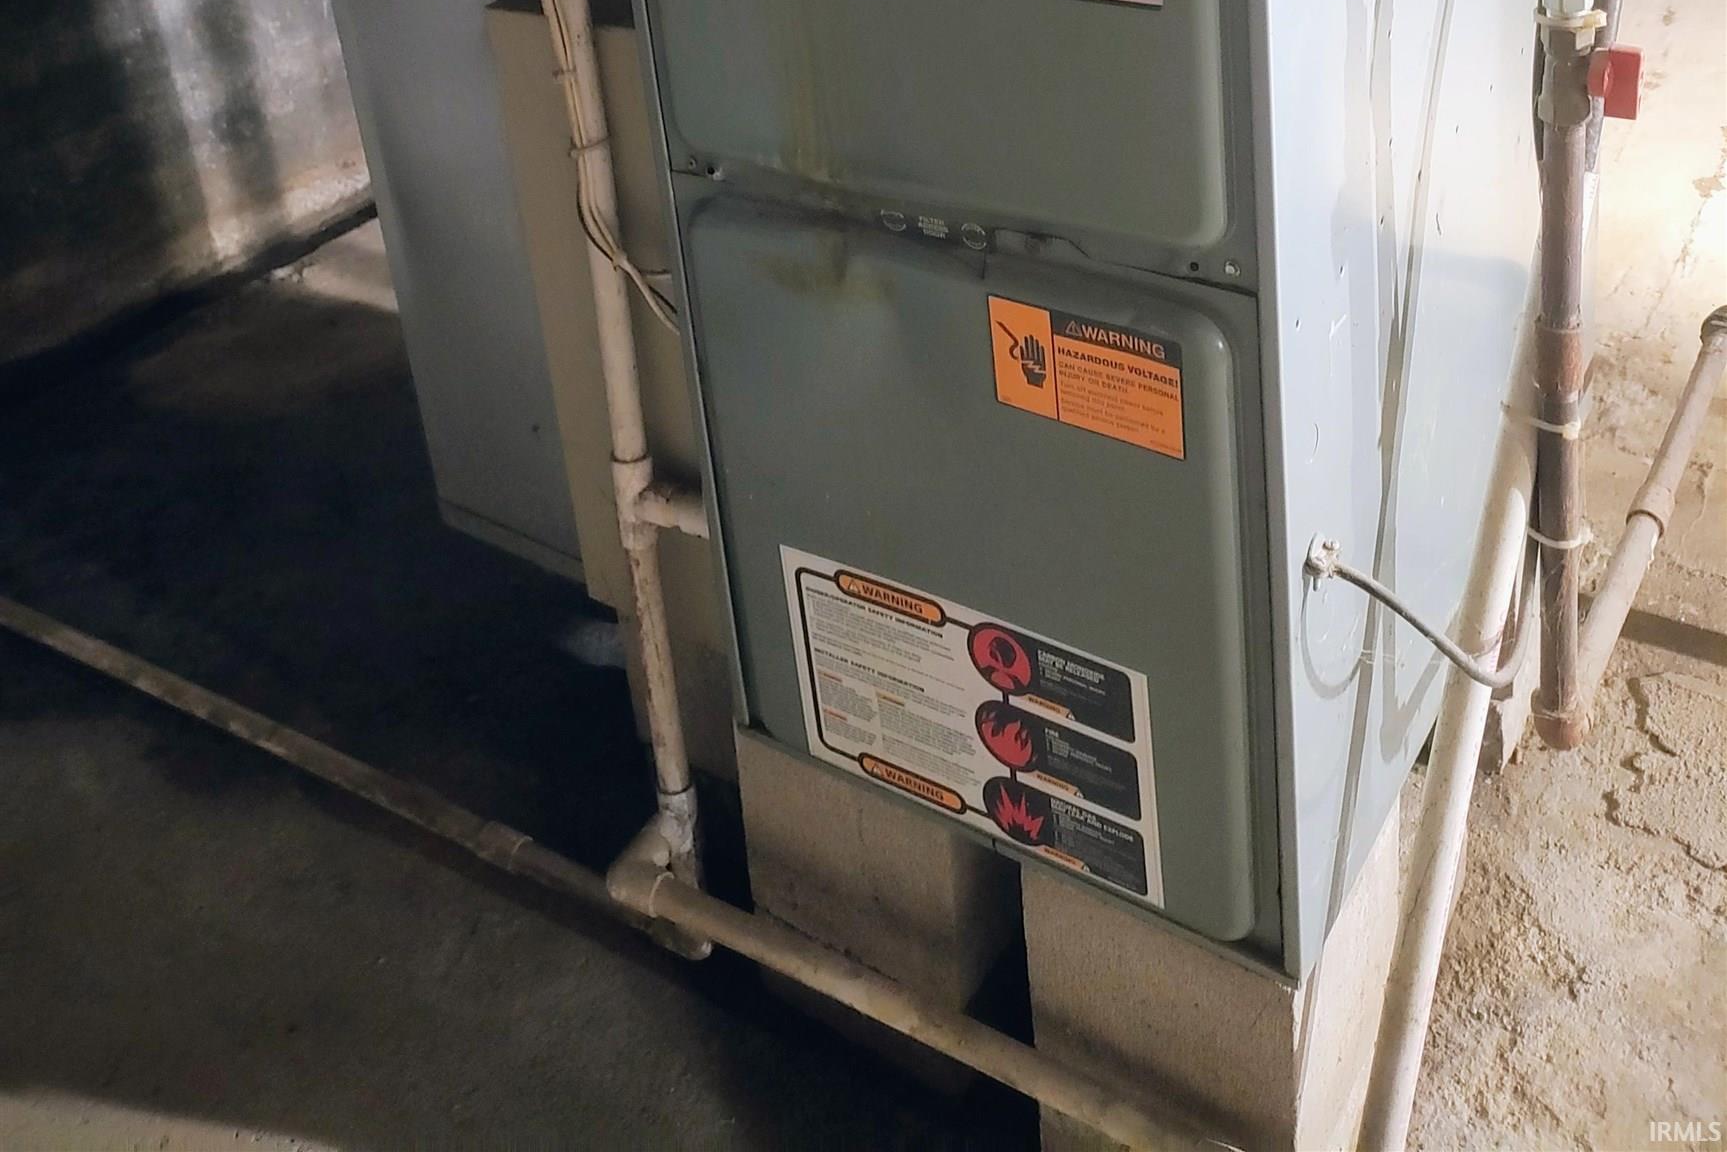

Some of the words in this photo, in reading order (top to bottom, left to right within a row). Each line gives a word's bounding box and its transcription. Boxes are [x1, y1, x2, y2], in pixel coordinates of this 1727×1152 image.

[1080, 323, 1166, 360] WARNING
[1058, 347, 1126, 371] HAZARDOUS
[1127, 365, 1179, 388] VOLTAGE!
[862, 584, 924, 615] WARNING
[885, 769, 945, 802] WARNING
